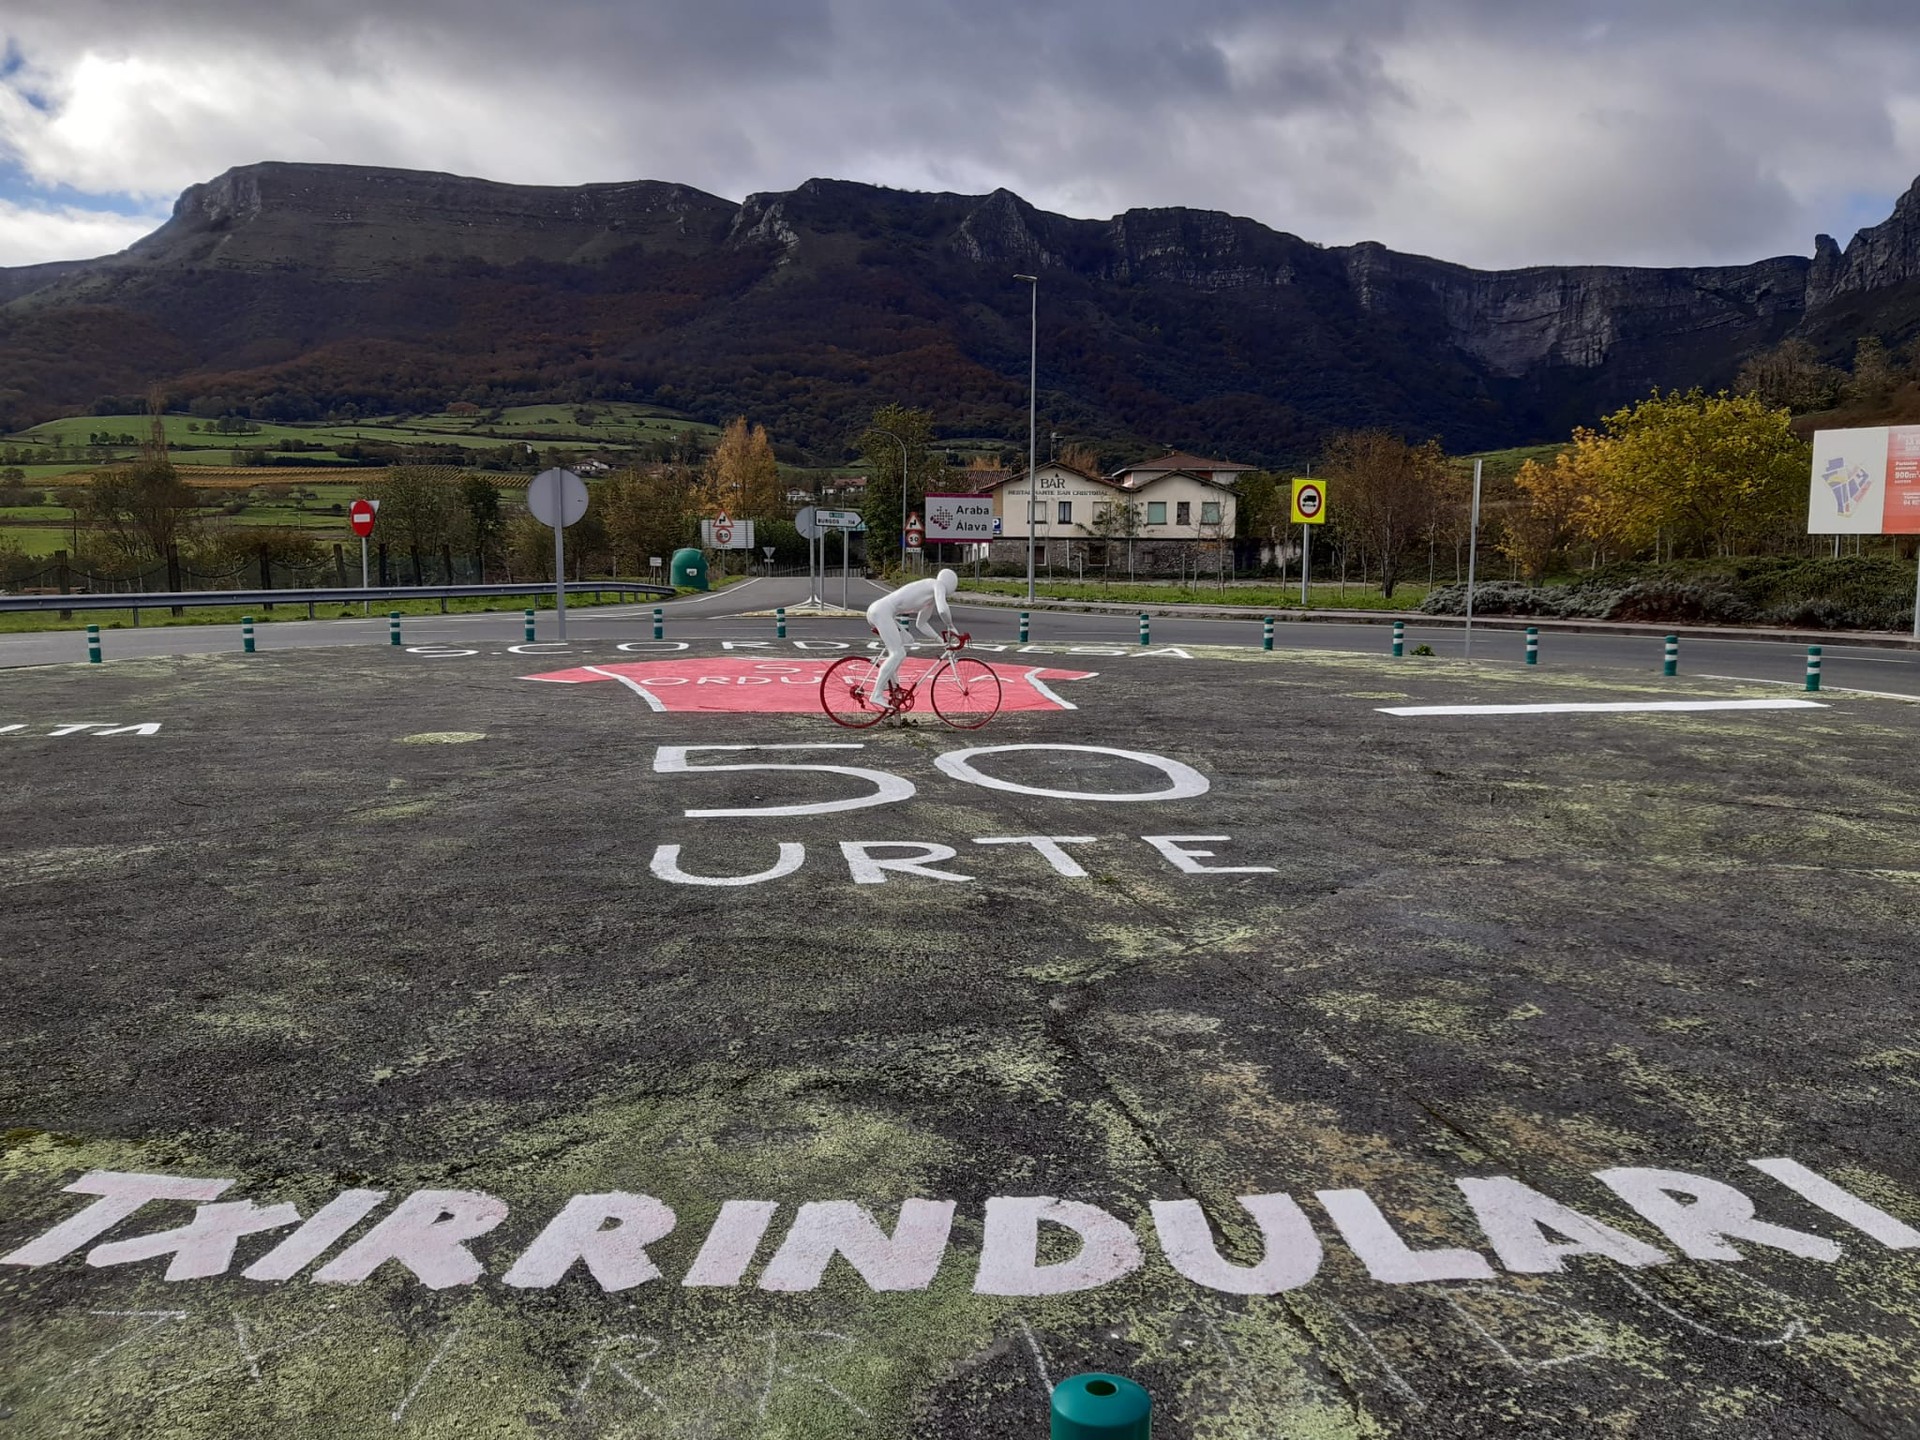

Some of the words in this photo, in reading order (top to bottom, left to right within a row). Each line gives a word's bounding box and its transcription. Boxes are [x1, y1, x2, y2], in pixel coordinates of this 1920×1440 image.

[1040, 478, 1066, 489] BAR
[955, 505, 990, 515] Araba
[955, 519, 988, 532] Álava
[653, 743, 1212, 819] 50
[648, 834, 1281, 888] URTE
[0, 1156, 1920, 1296] TXIRRINDULARI
